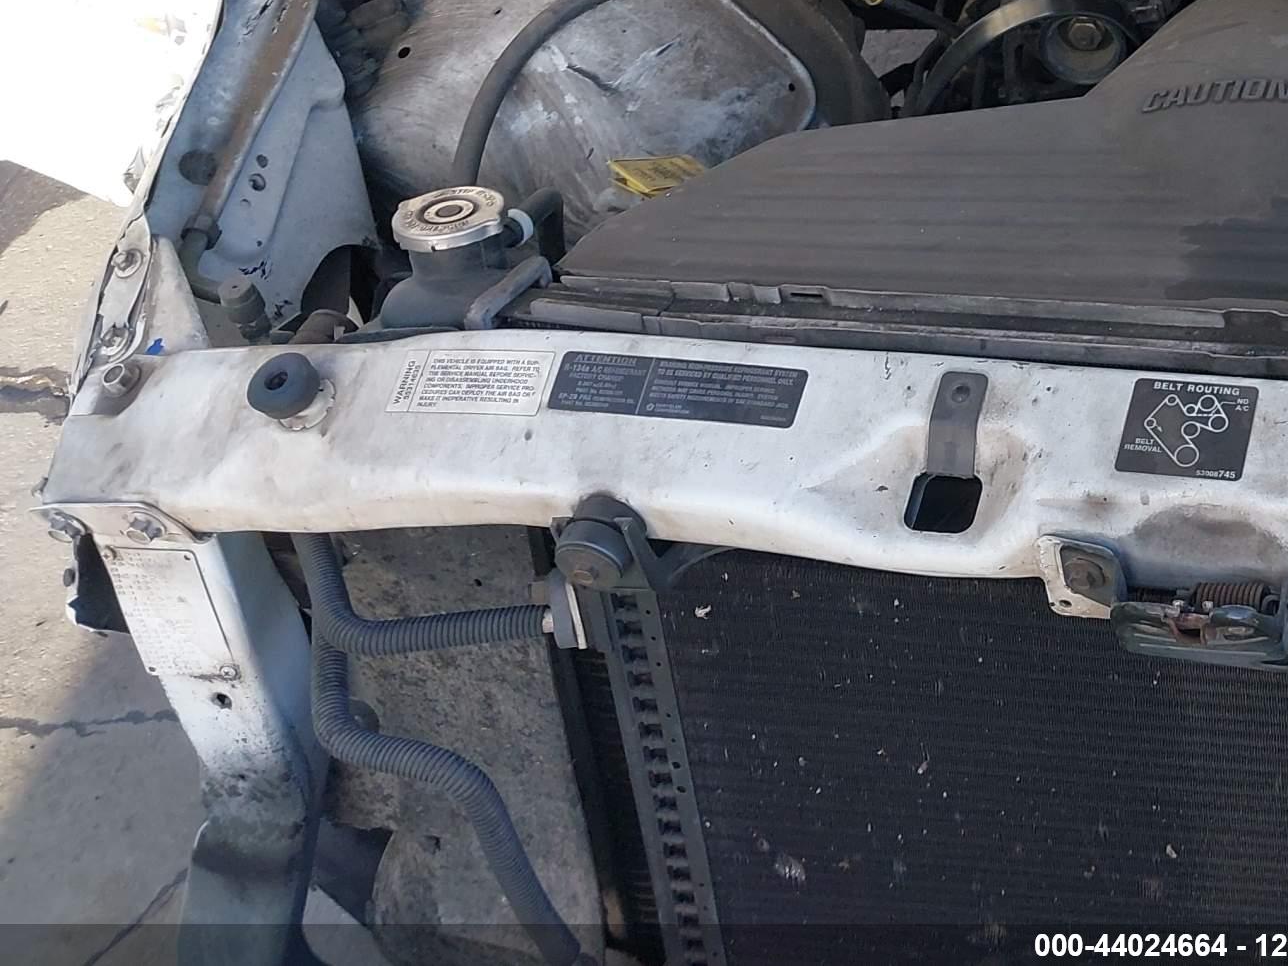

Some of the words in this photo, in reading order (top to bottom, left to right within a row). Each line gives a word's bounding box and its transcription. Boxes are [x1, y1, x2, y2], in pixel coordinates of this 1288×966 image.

[574, 354, 638, 364] ATTENTION
[393, 360, 416, 405] WARNING
[1154, 381, 1184, 392] BELT
[1187, 384, 1240, 396] ROUTING
[1124, 444, 1163, 453] REMOVAL
